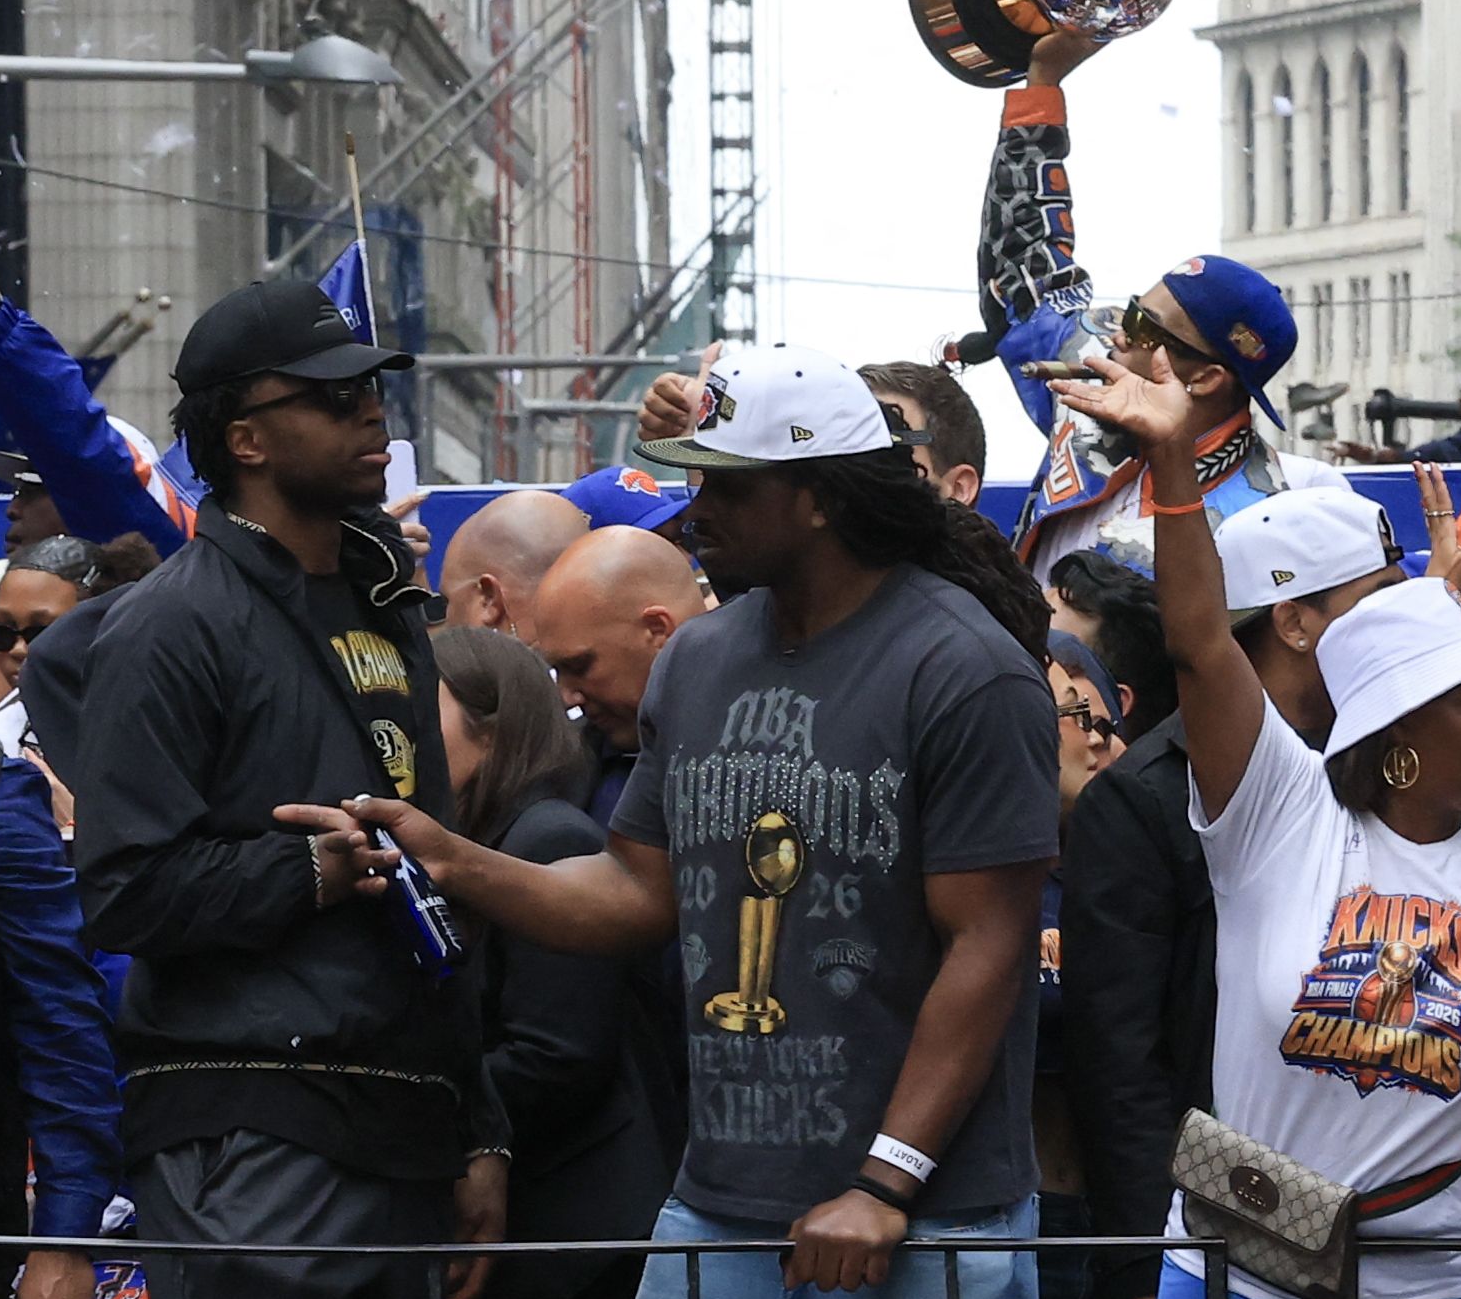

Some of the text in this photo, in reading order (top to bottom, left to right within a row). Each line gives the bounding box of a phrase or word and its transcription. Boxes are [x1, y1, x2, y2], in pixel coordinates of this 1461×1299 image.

[805, 873, 864, 920] 26
[1325, 981, 1356, 998] FINALS
[1425, 1002, 1461, 1027] 2026
[894, 1149, 924, 1170] FLOAT
